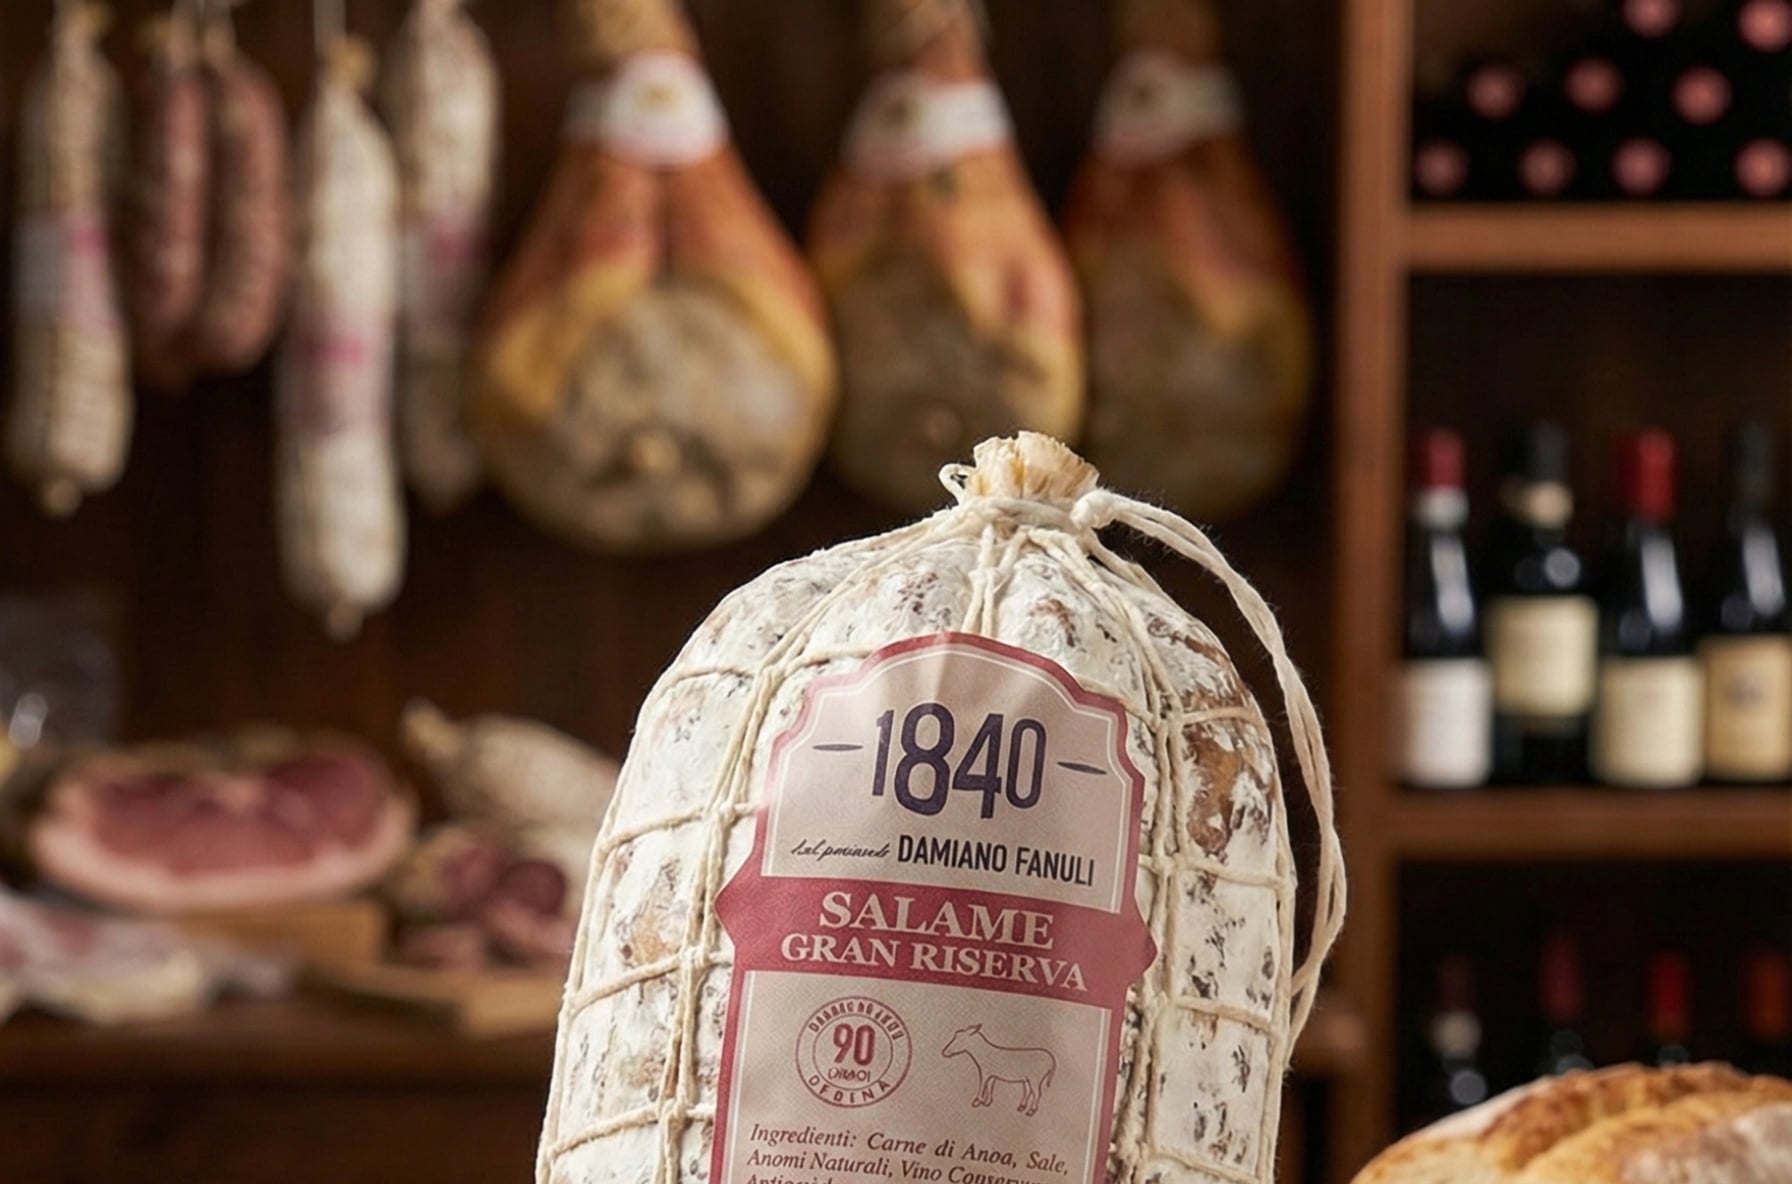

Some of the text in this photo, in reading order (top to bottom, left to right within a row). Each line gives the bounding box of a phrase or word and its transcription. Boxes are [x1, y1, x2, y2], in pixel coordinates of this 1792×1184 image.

[872, 702, 1047, 819] 1840
[897, 834, 1007, 872] DAMIANO
[1015, 847, 1095, 887] FANULI
[819, 891, 1054, 949] SALAME
[781, 933, 1088, 992] GRAN RISERVA
[833, 1023, 876, 1066] 90
[746, 1149, 807, 1170] Anomi
[809, 1151, 894, 1179] Naturali,
[901, 1159, 943, 1182] Vino
[750, 1123, 857, 1147] Ingredienti:
[867, 1132, 927, 1155] Carne
[934, 1139, 956, 1158] di
